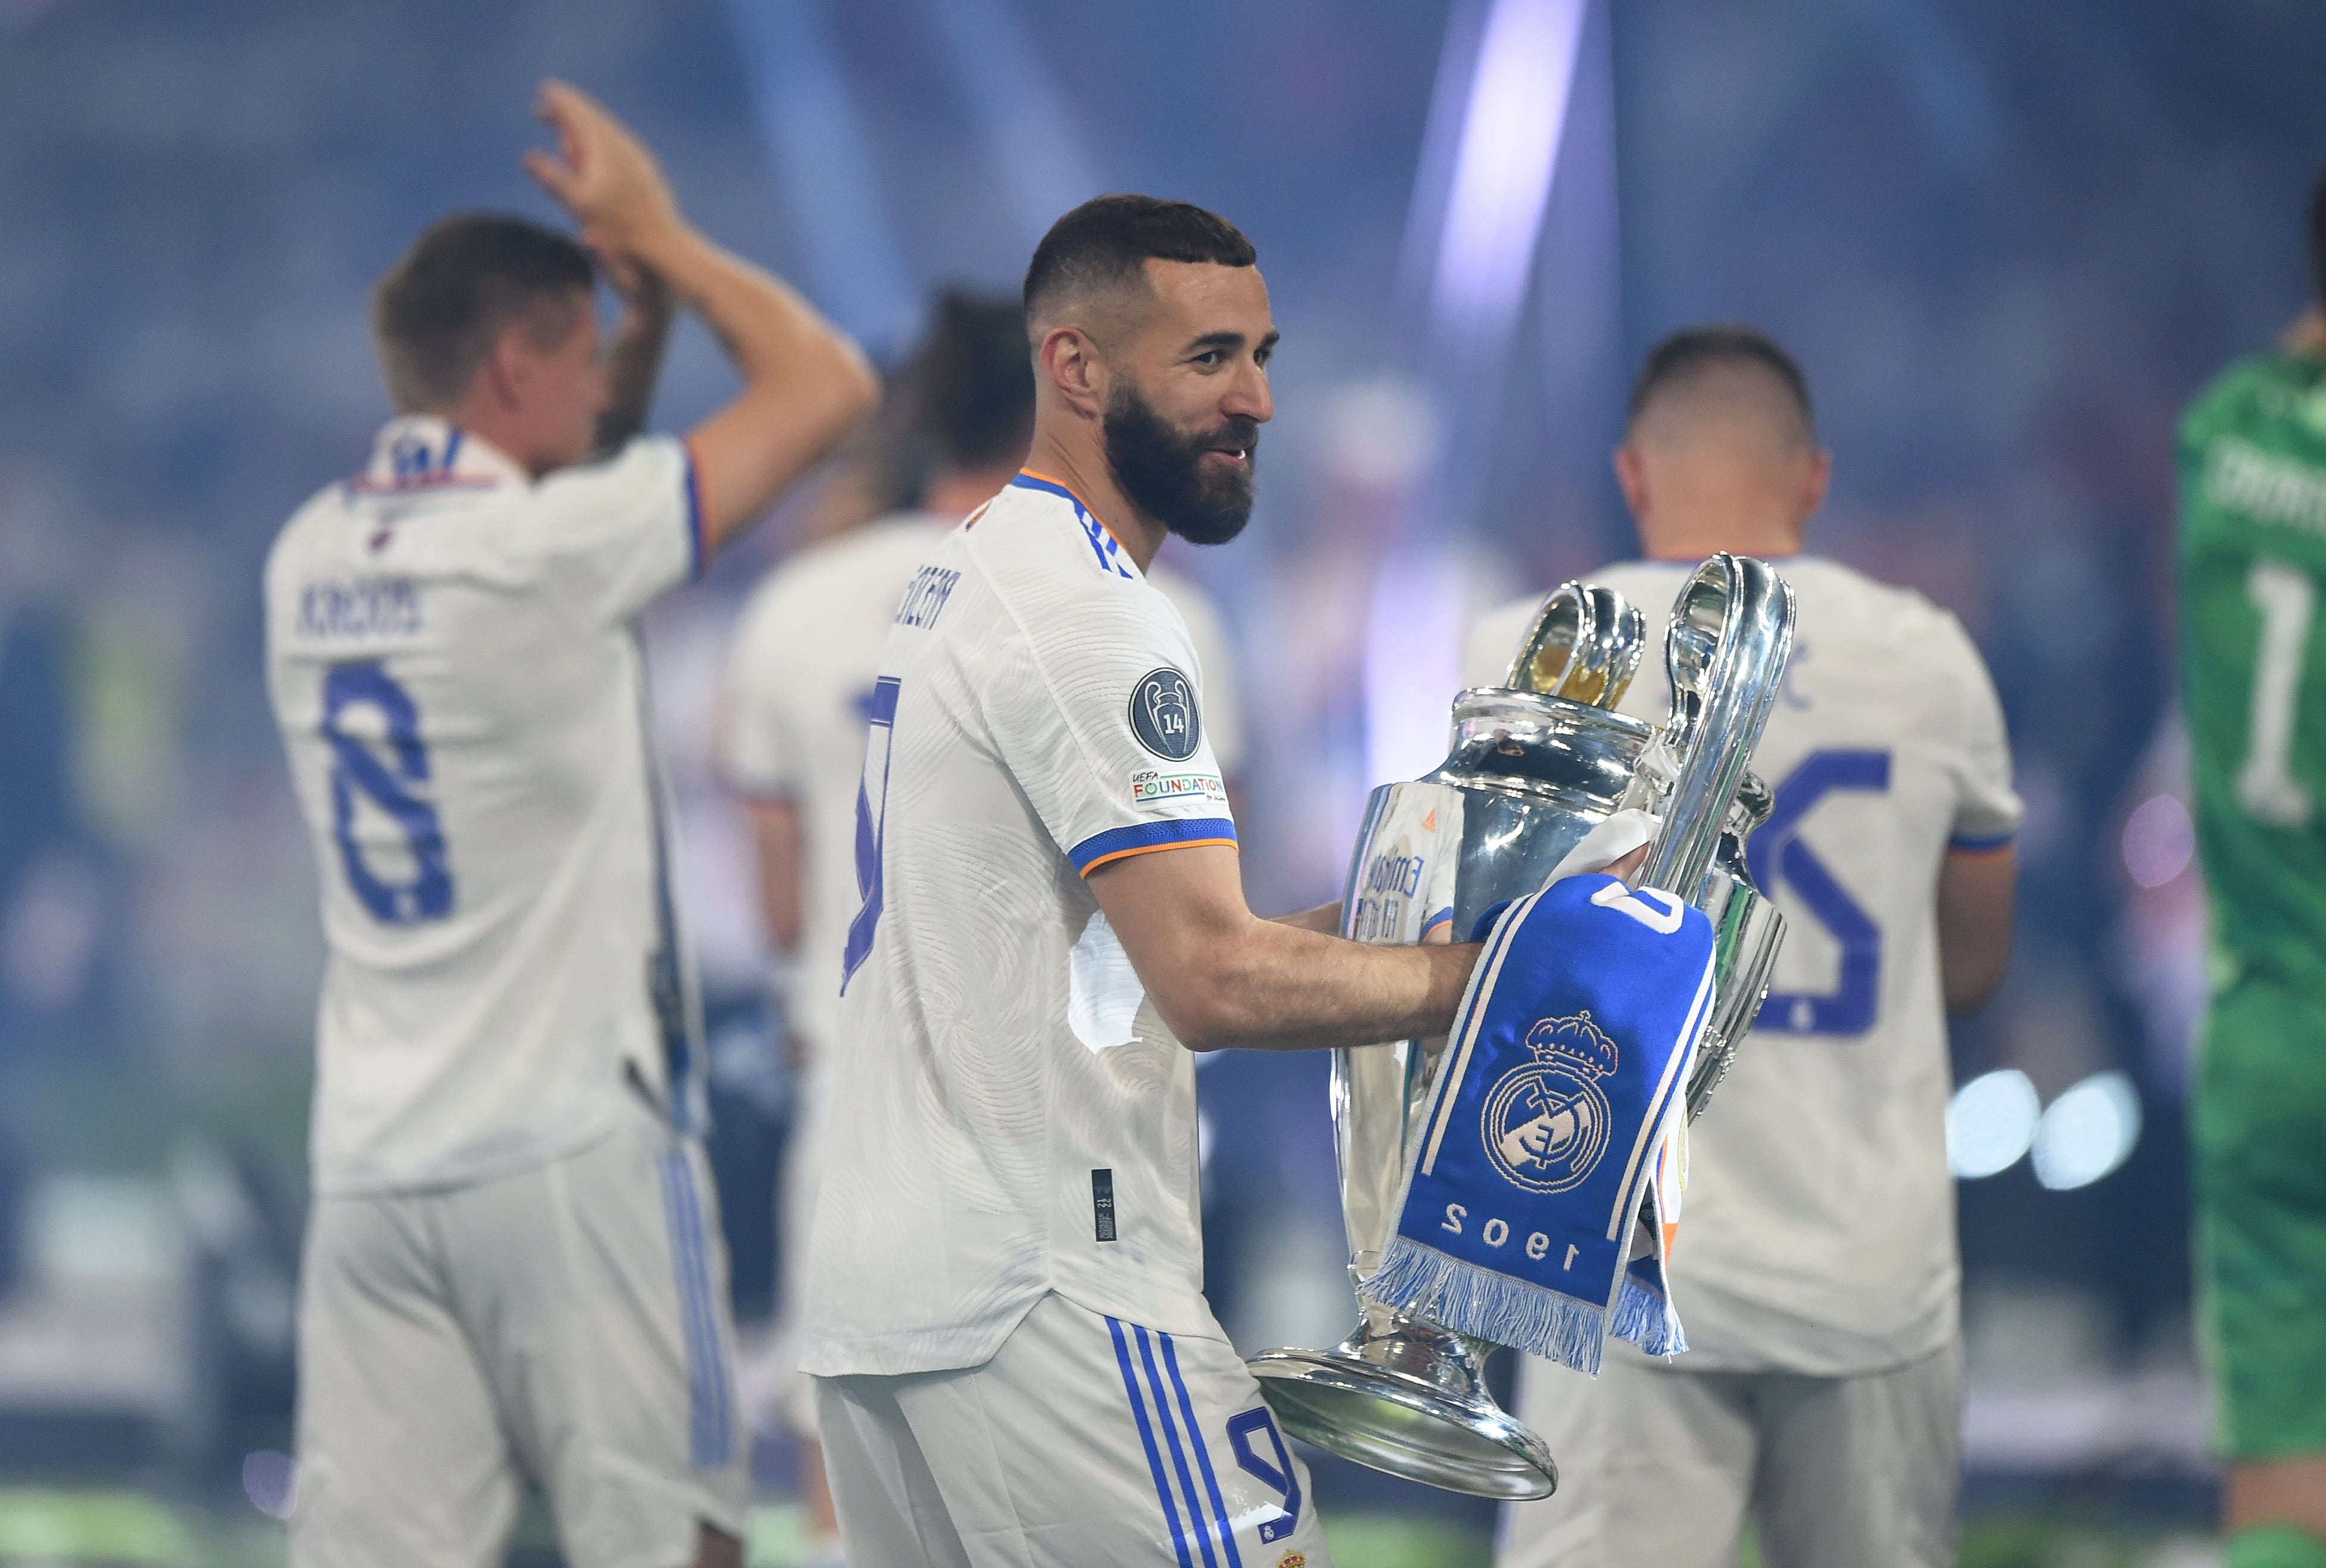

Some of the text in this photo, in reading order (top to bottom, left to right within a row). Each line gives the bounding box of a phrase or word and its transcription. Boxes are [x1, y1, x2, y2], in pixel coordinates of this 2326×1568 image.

[1163, 713, 1184, 734] 14
[2239, 563, 2315, 825] 1
[322, 660, 455, 927] 8
[1133, 771, 1159, 783] UEFA
[1226, 1406, 1302, 1545] 9
